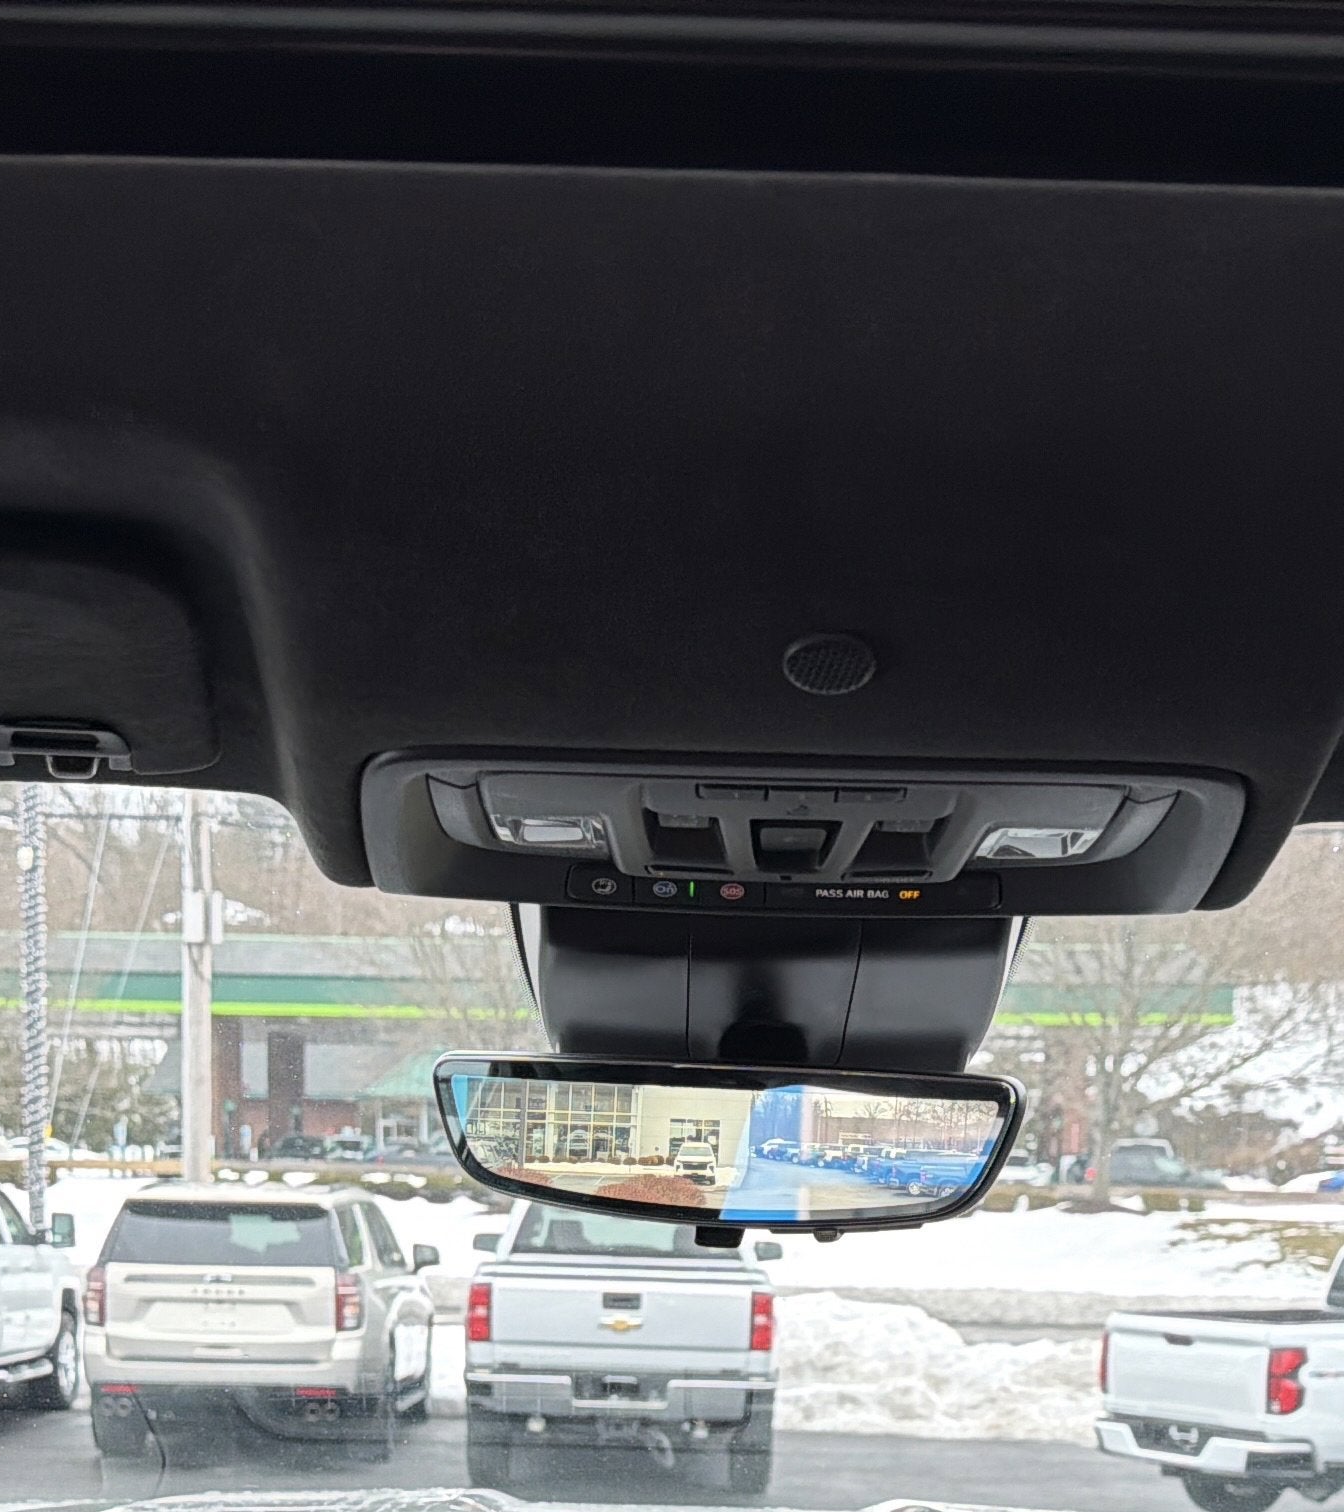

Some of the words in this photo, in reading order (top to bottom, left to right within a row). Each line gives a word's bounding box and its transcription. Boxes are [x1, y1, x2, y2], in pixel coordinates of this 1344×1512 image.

[816, 888, 843, 898] PASS
[845, 889, 865, 898] AIR
[867, 889, 889, 899] BAG
[899, 890, 921, 899] OFF
